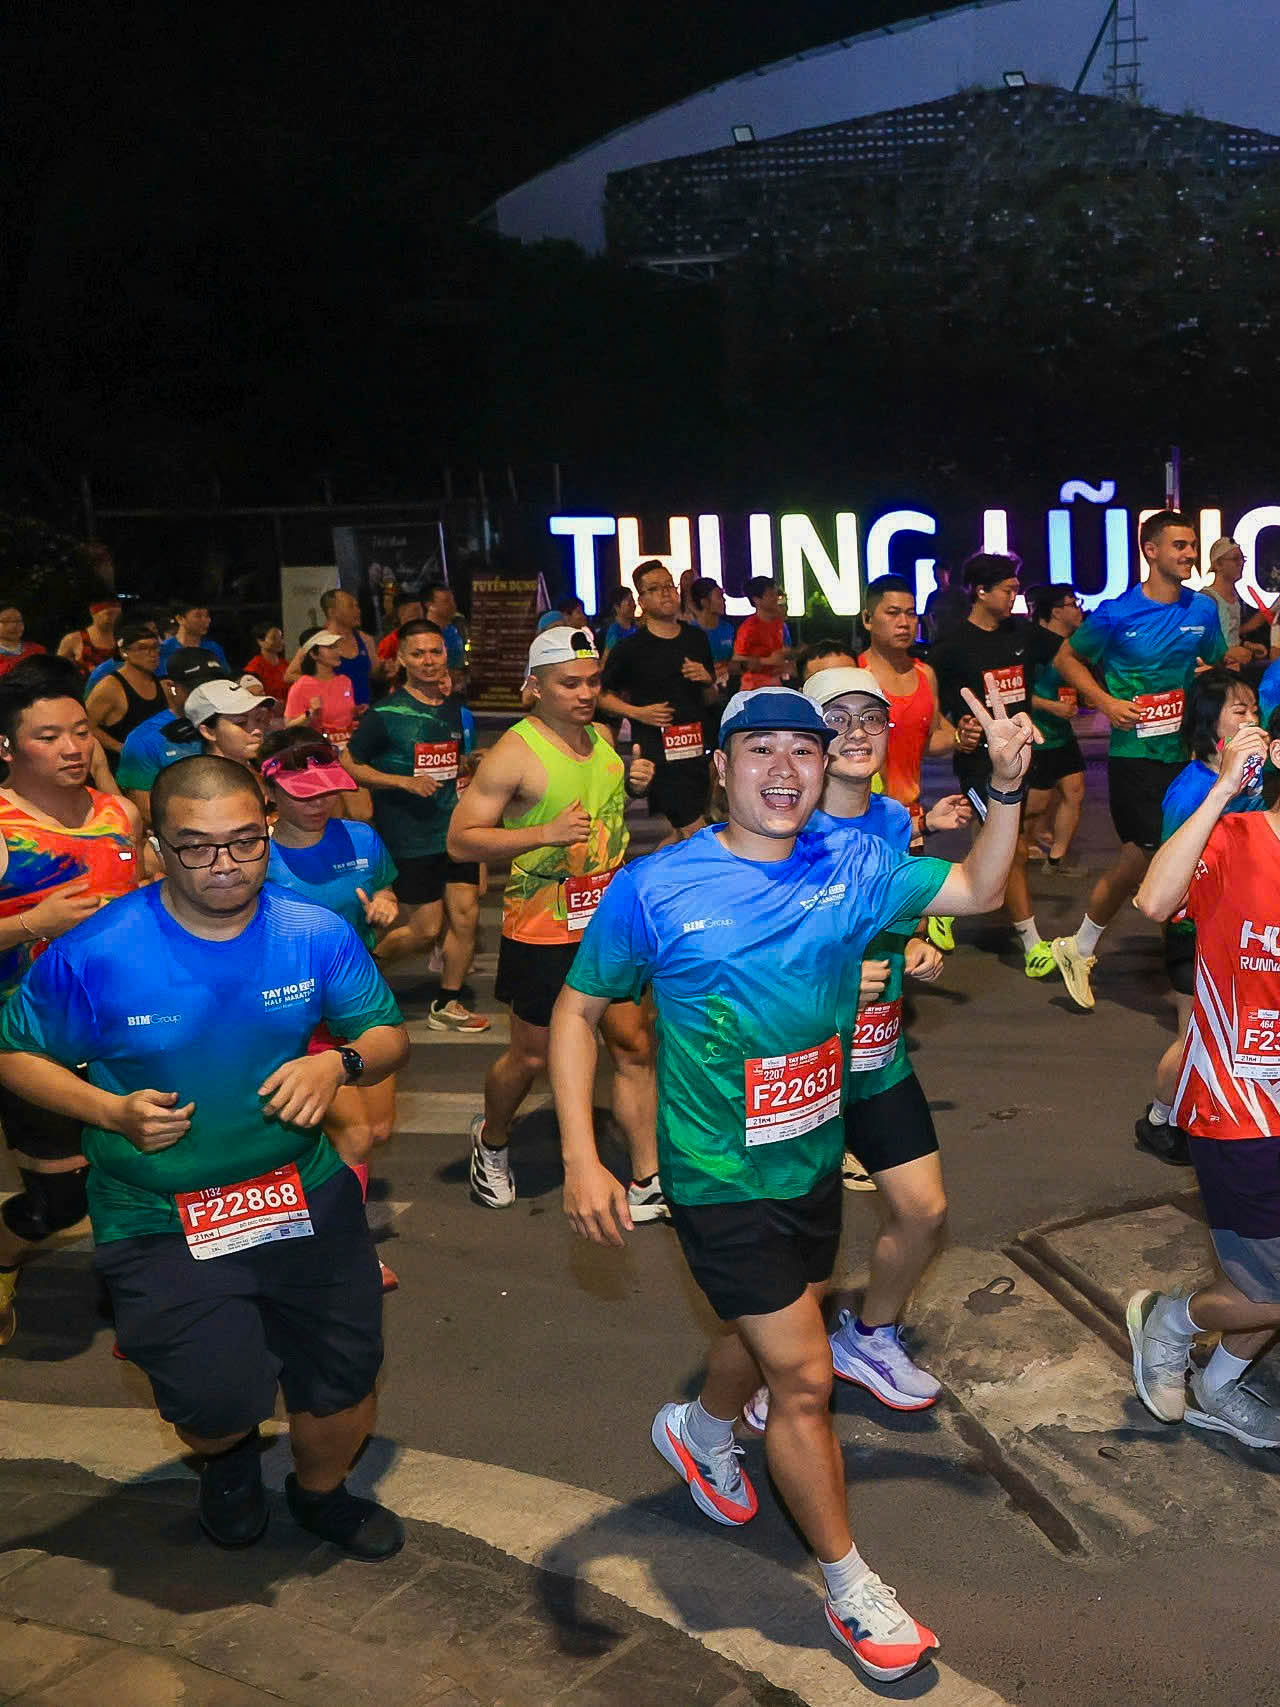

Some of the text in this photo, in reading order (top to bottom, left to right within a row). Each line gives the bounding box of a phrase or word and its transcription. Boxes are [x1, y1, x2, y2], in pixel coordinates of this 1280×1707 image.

[550, 511, 936, 617] THUNG
[571, 887, 605, 908] E23
[261, 988, 282, 999] TAY
[282, 984, 298, 996] HO
[264, 987, 315, 1006] HALF MARATN
[127, 1013, 182, 1026] BIMGroup
[763, 1068, 785, 1081] 2207
[753, 1063, 836, 1110] F22631
[199, 1187, 222, 1200] 1132
[187, 1183, 298, 1228] F22868
